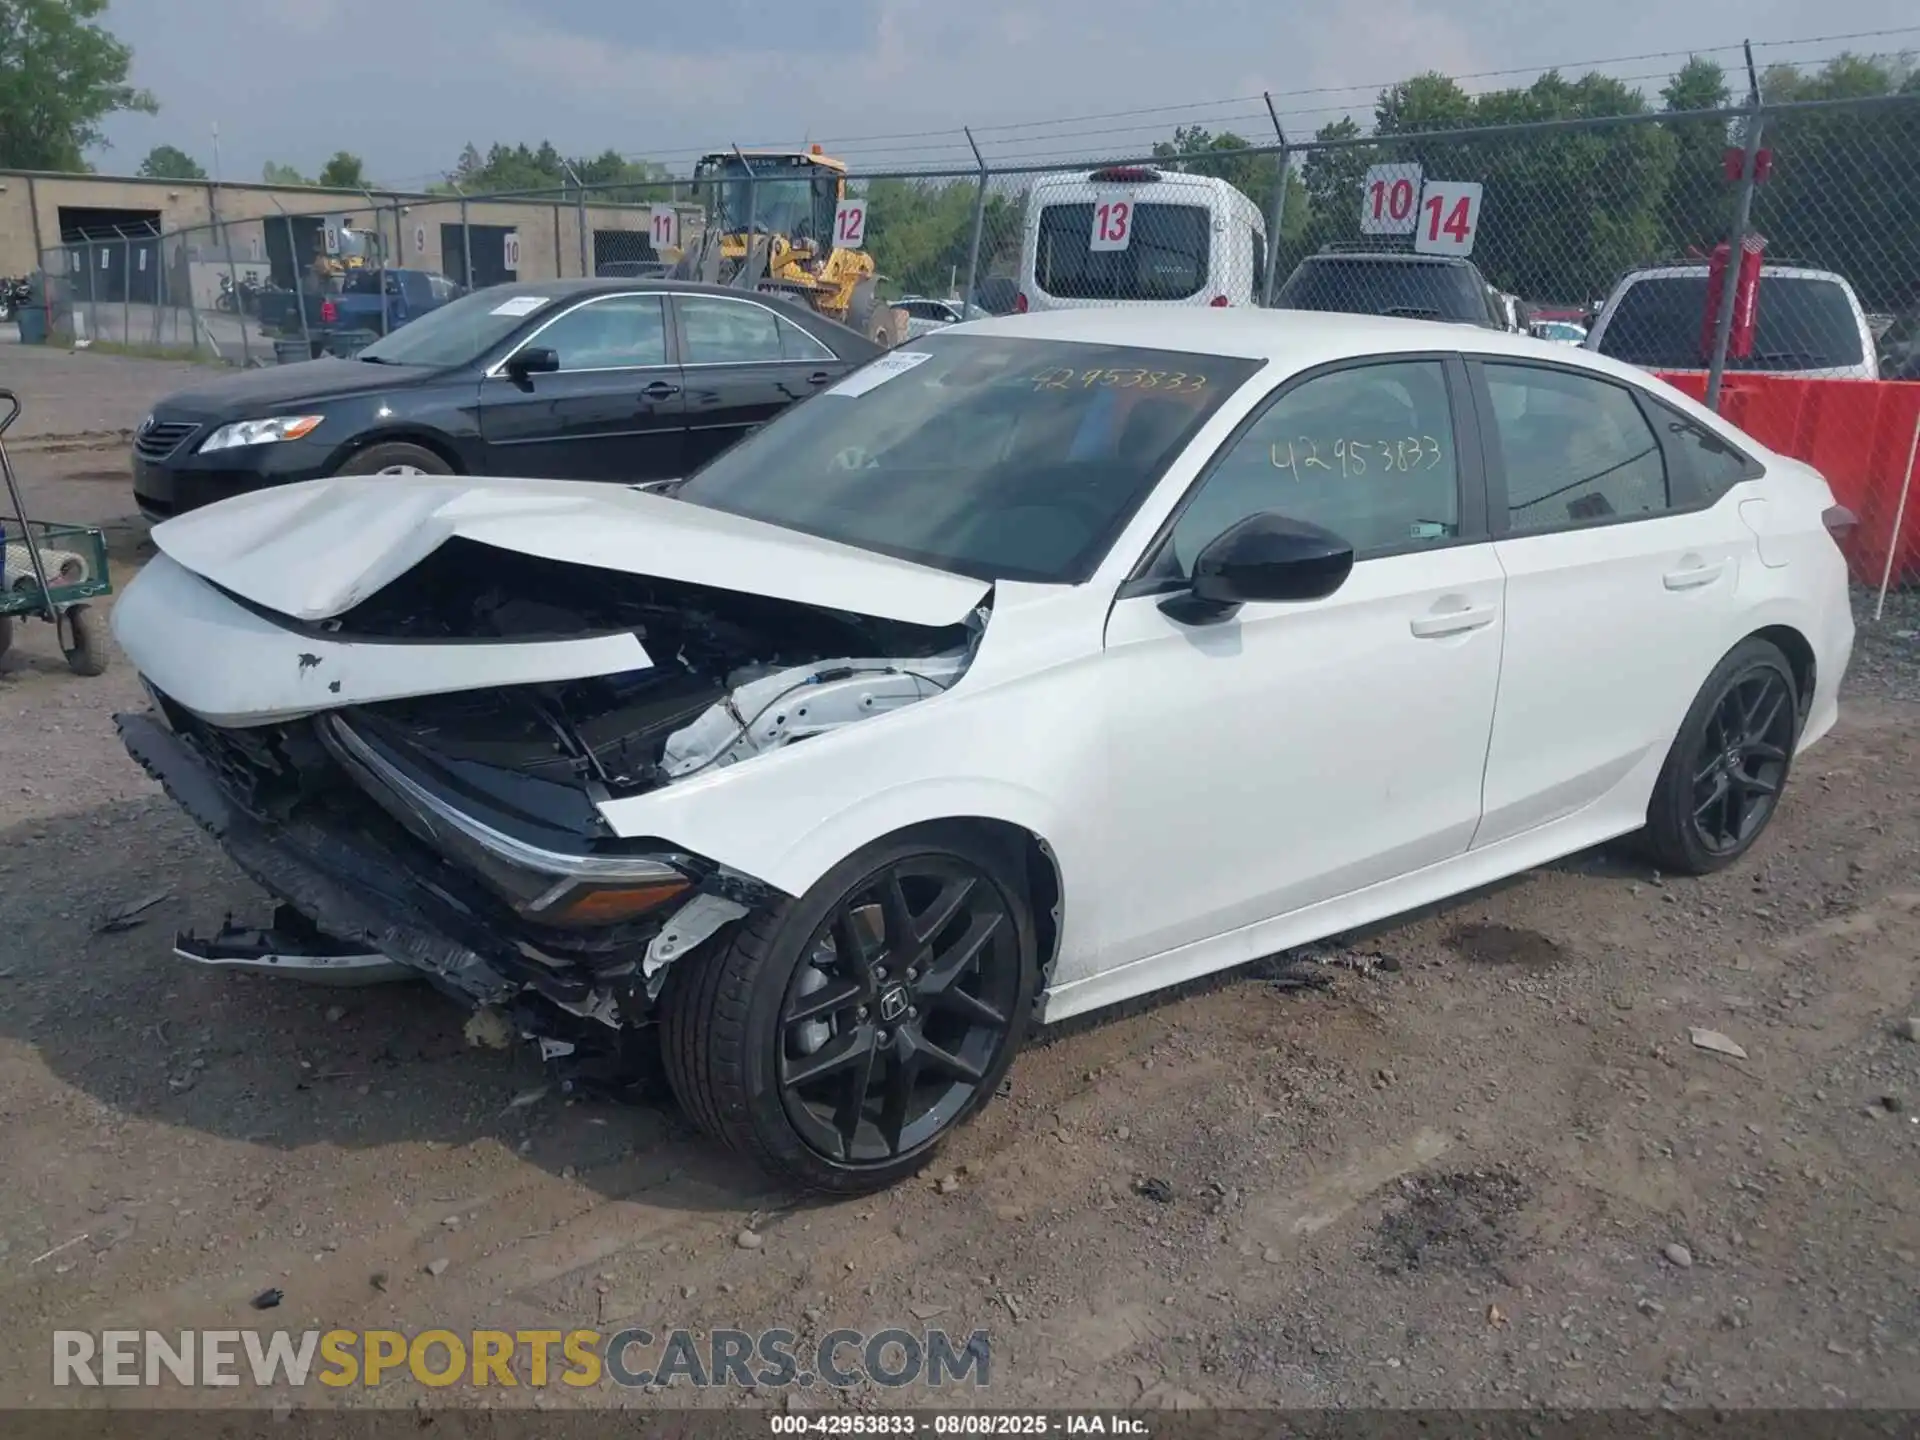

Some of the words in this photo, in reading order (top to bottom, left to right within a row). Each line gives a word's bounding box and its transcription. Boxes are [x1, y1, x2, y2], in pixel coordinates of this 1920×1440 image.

[1370, 178, 1413, 220] 10
[653, 215, 671, 242] 11
[837, 208, 862, 240] 12
[1098, 202, 1128, 241] 13
[1425, 195, 1471, 243] 14
[327, 230, 336, 249] 8
[416, 229, 425, 251] 9
[506, 241, 519, 263] 10
[1272, 435, 1442, 483] 42953833
